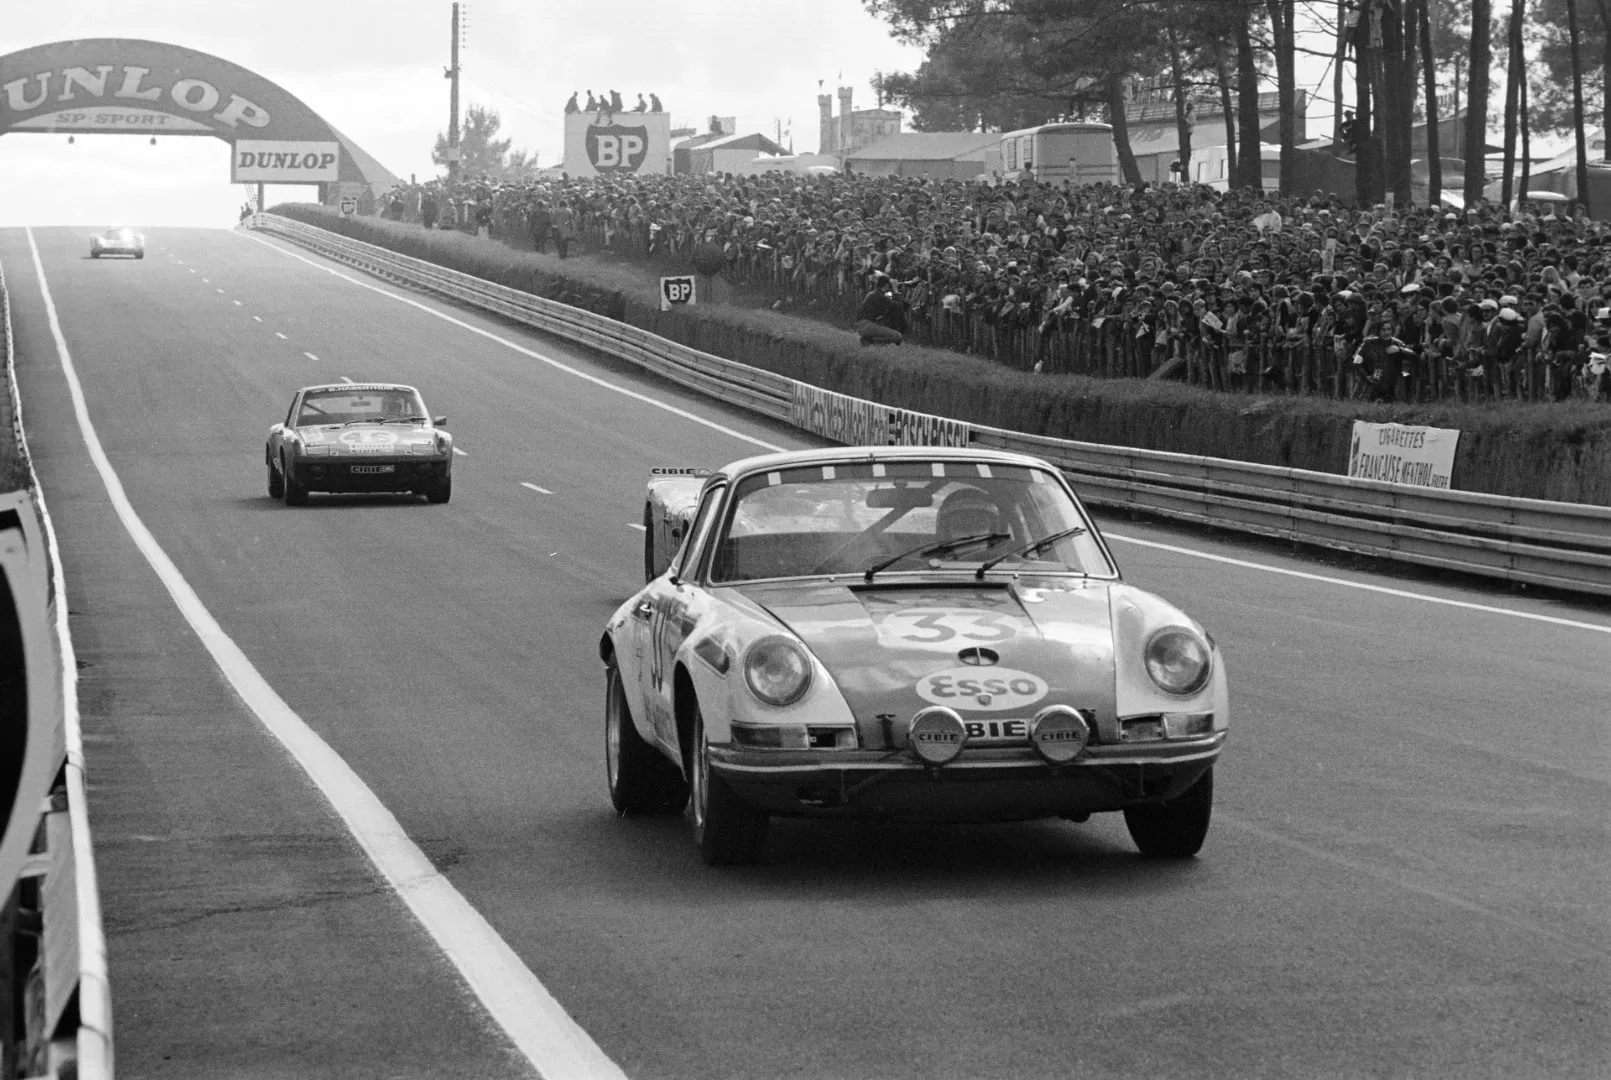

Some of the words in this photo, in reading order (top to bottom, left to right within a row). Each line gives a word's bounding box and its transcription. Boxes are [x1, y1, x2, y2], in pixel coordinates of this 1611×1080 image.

[2, 66, 271, 129] UNLOP
[56, 113, 86, 124] SP
[94, 113, 171, 125] SPORT
[595, 135, 643, 167] BP
[237, 152, 336, 169] DUNLOP
[668, 283, 690, 300] BP
[1379, 427, 1426, 449] CIGARETTES
[895, 611, 1017, 643] 33
[919, 733, 959, 741] CIBIE
[964, 720, 1027, 737] BIE
